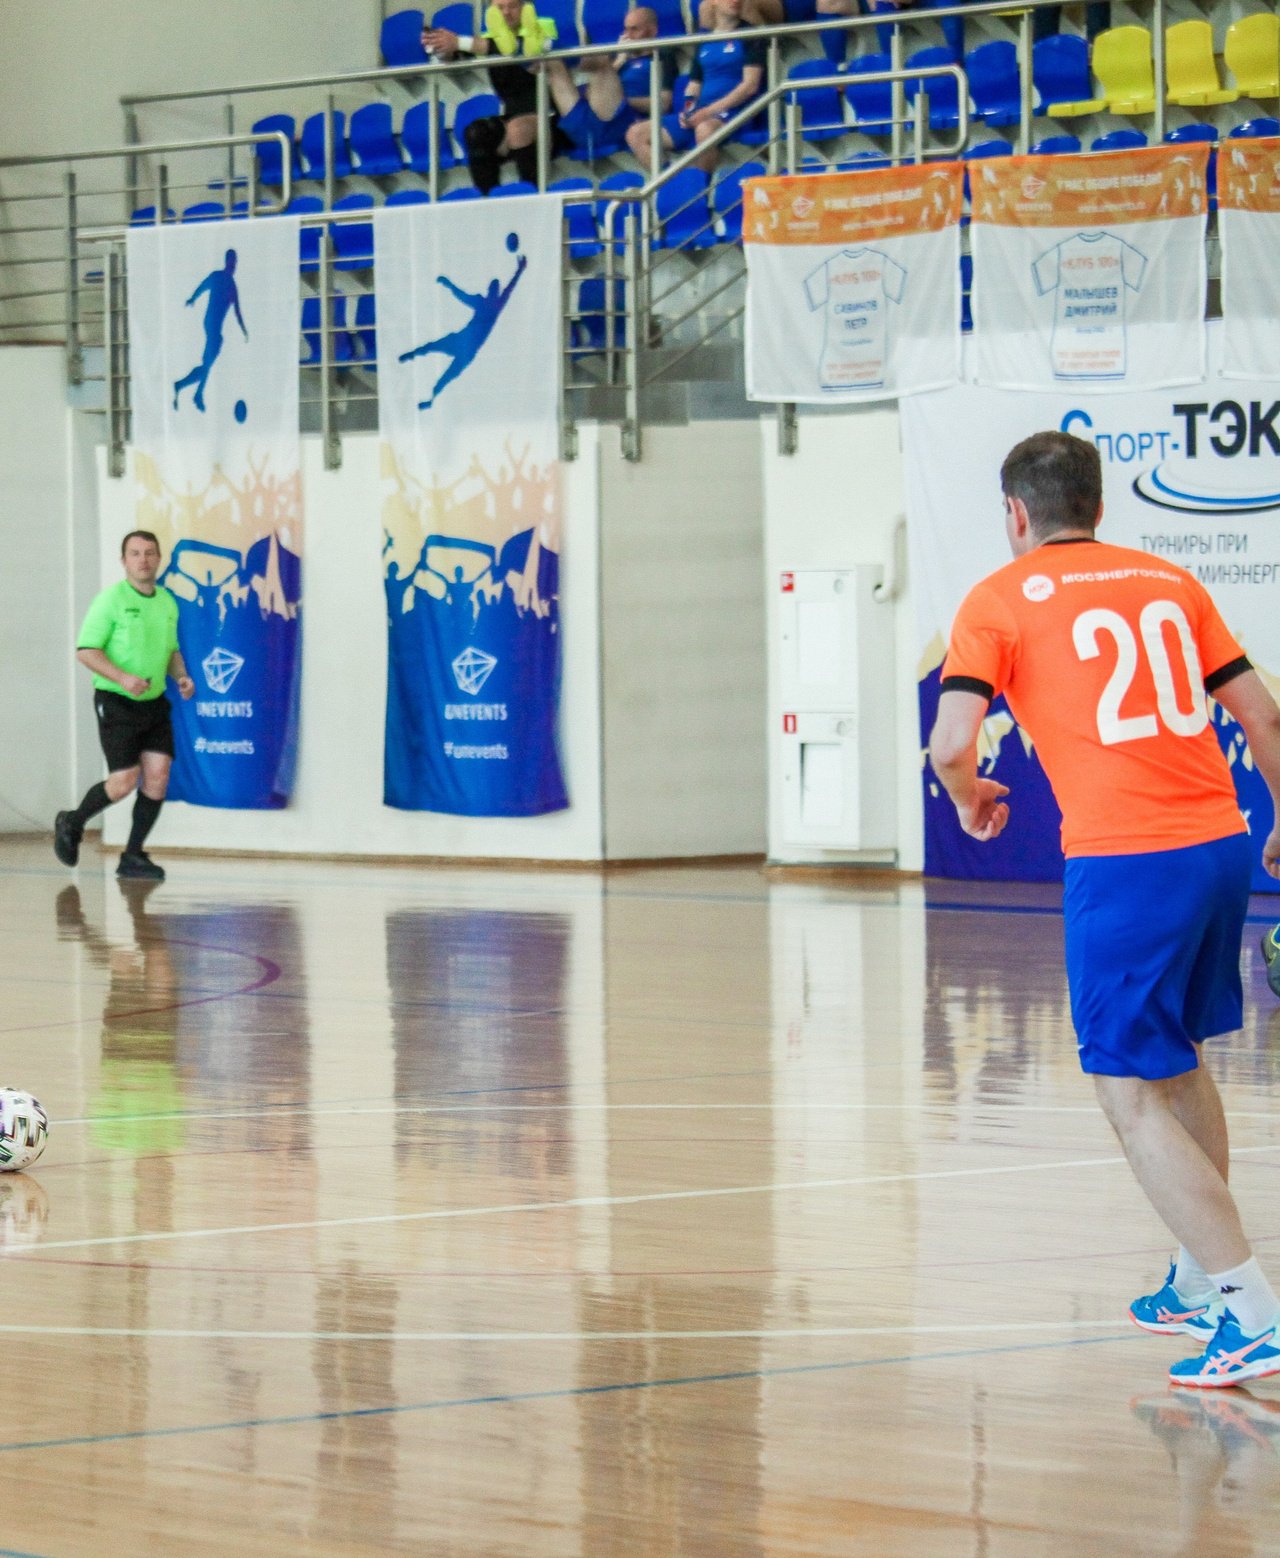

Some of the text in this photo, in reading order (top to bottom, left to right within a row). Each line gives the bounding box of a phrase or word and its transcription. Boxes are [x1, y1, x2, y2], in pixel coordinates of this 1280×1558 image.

[1064, 286, 1118, 299] МАЛЫШЕВ
[1064, 302, 1117, 318] ДМИТРИЙ
[1140, 534, 1248, 555] ТУРНИРЫ ПРИ
[1072, 600, 1209, 746] 20
[444, 703, 508, 720] UNEVENTS
[194, 736, 255, 754] #unevents
[443, 742, 508, 759] #unevents
